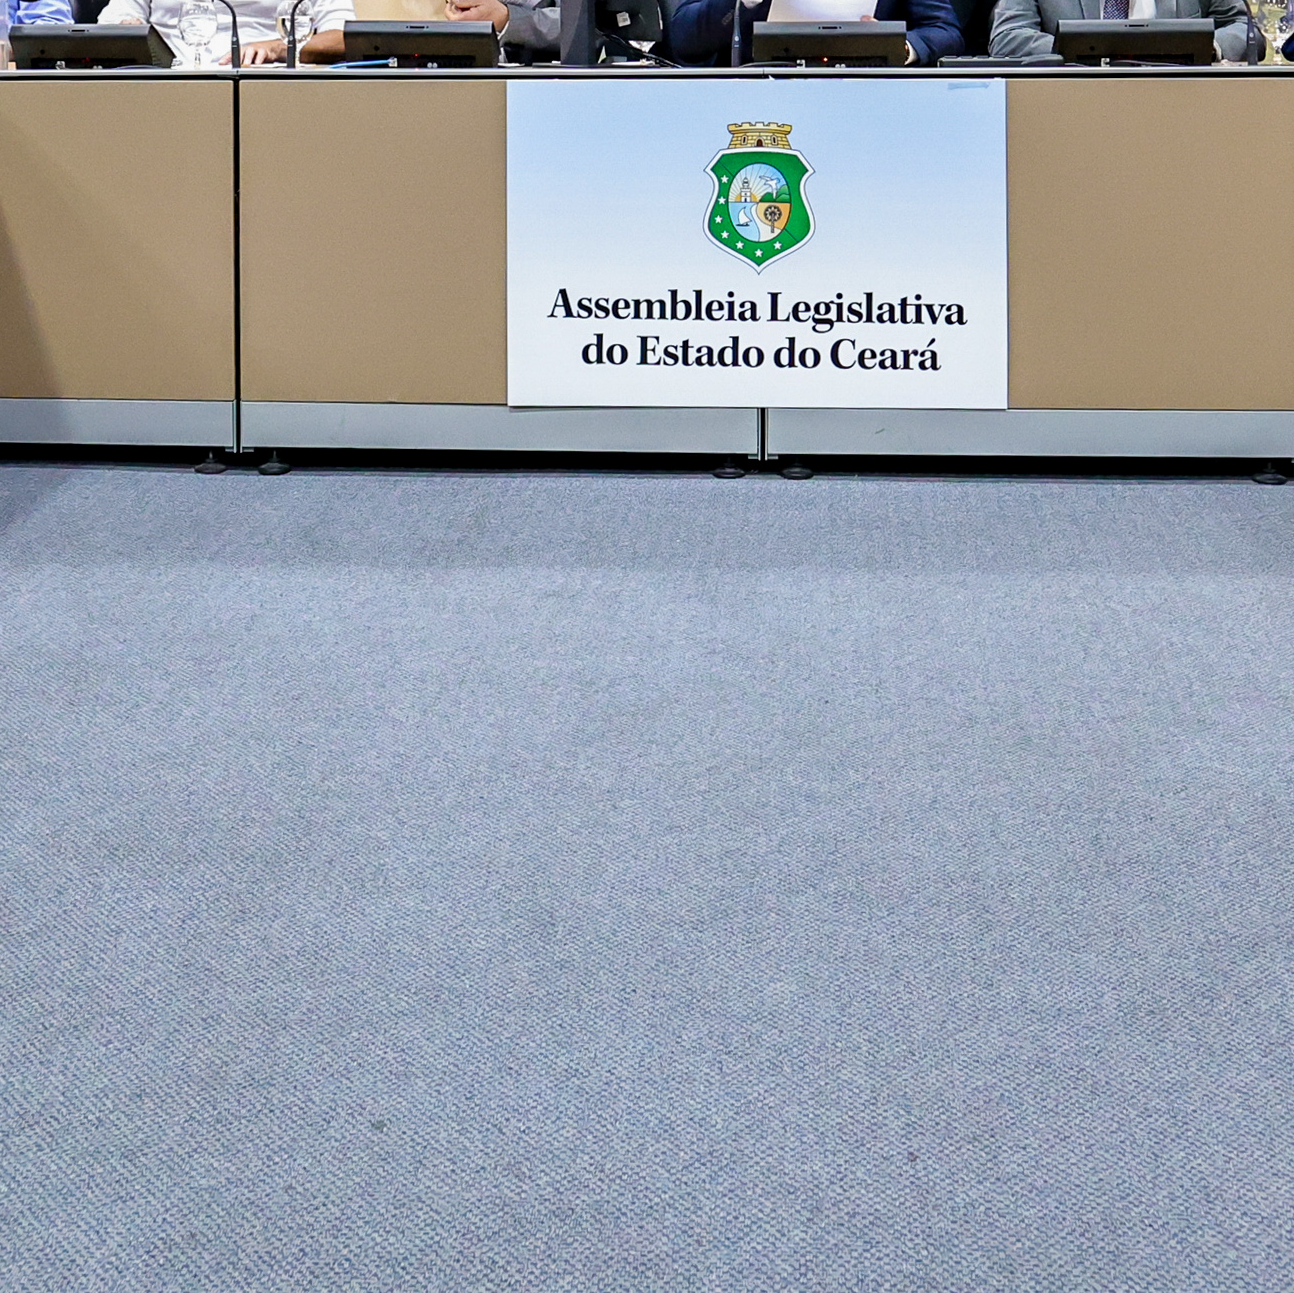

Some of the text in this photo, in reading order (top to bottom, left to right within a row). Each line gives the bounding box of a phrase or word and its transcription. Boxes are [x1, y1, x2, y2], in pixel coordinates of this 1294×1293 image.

[547, 288, 968, 333] Assembleia Legislativa
[582, 333, 941, 371] do Estado do Ceará
